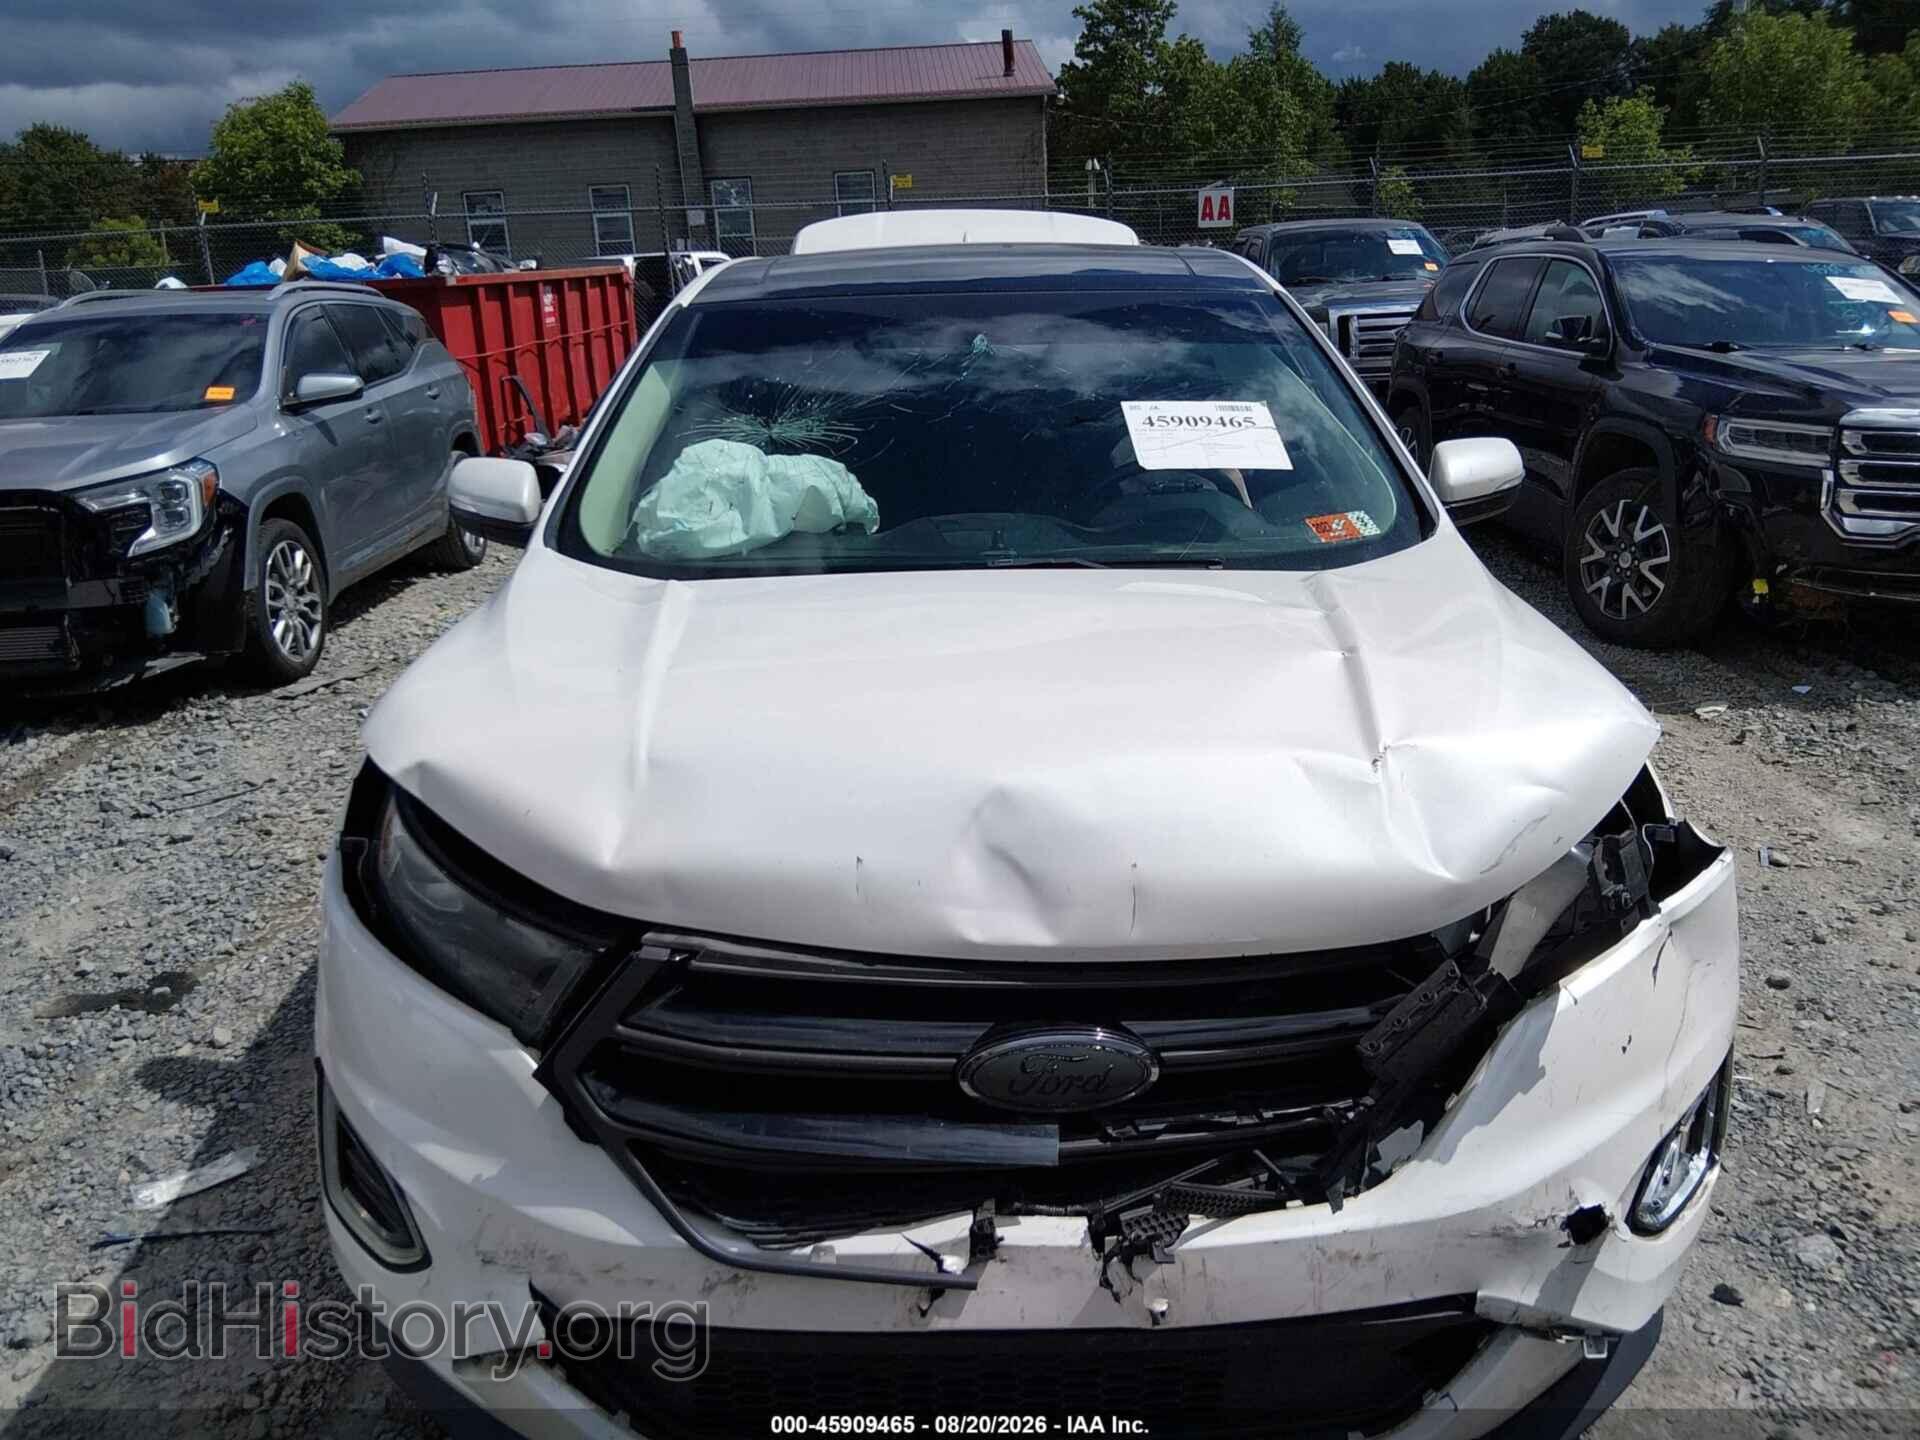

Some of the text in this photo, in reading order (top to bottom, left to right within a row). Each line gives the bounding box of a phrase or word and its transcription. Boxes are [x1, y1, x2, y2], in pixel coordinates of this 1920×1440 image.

[1200, 195, 1232, 221] AA
[1142, 414, 1257, 428] 45909465
[1008, 1053, 1114, 1095] Ford
